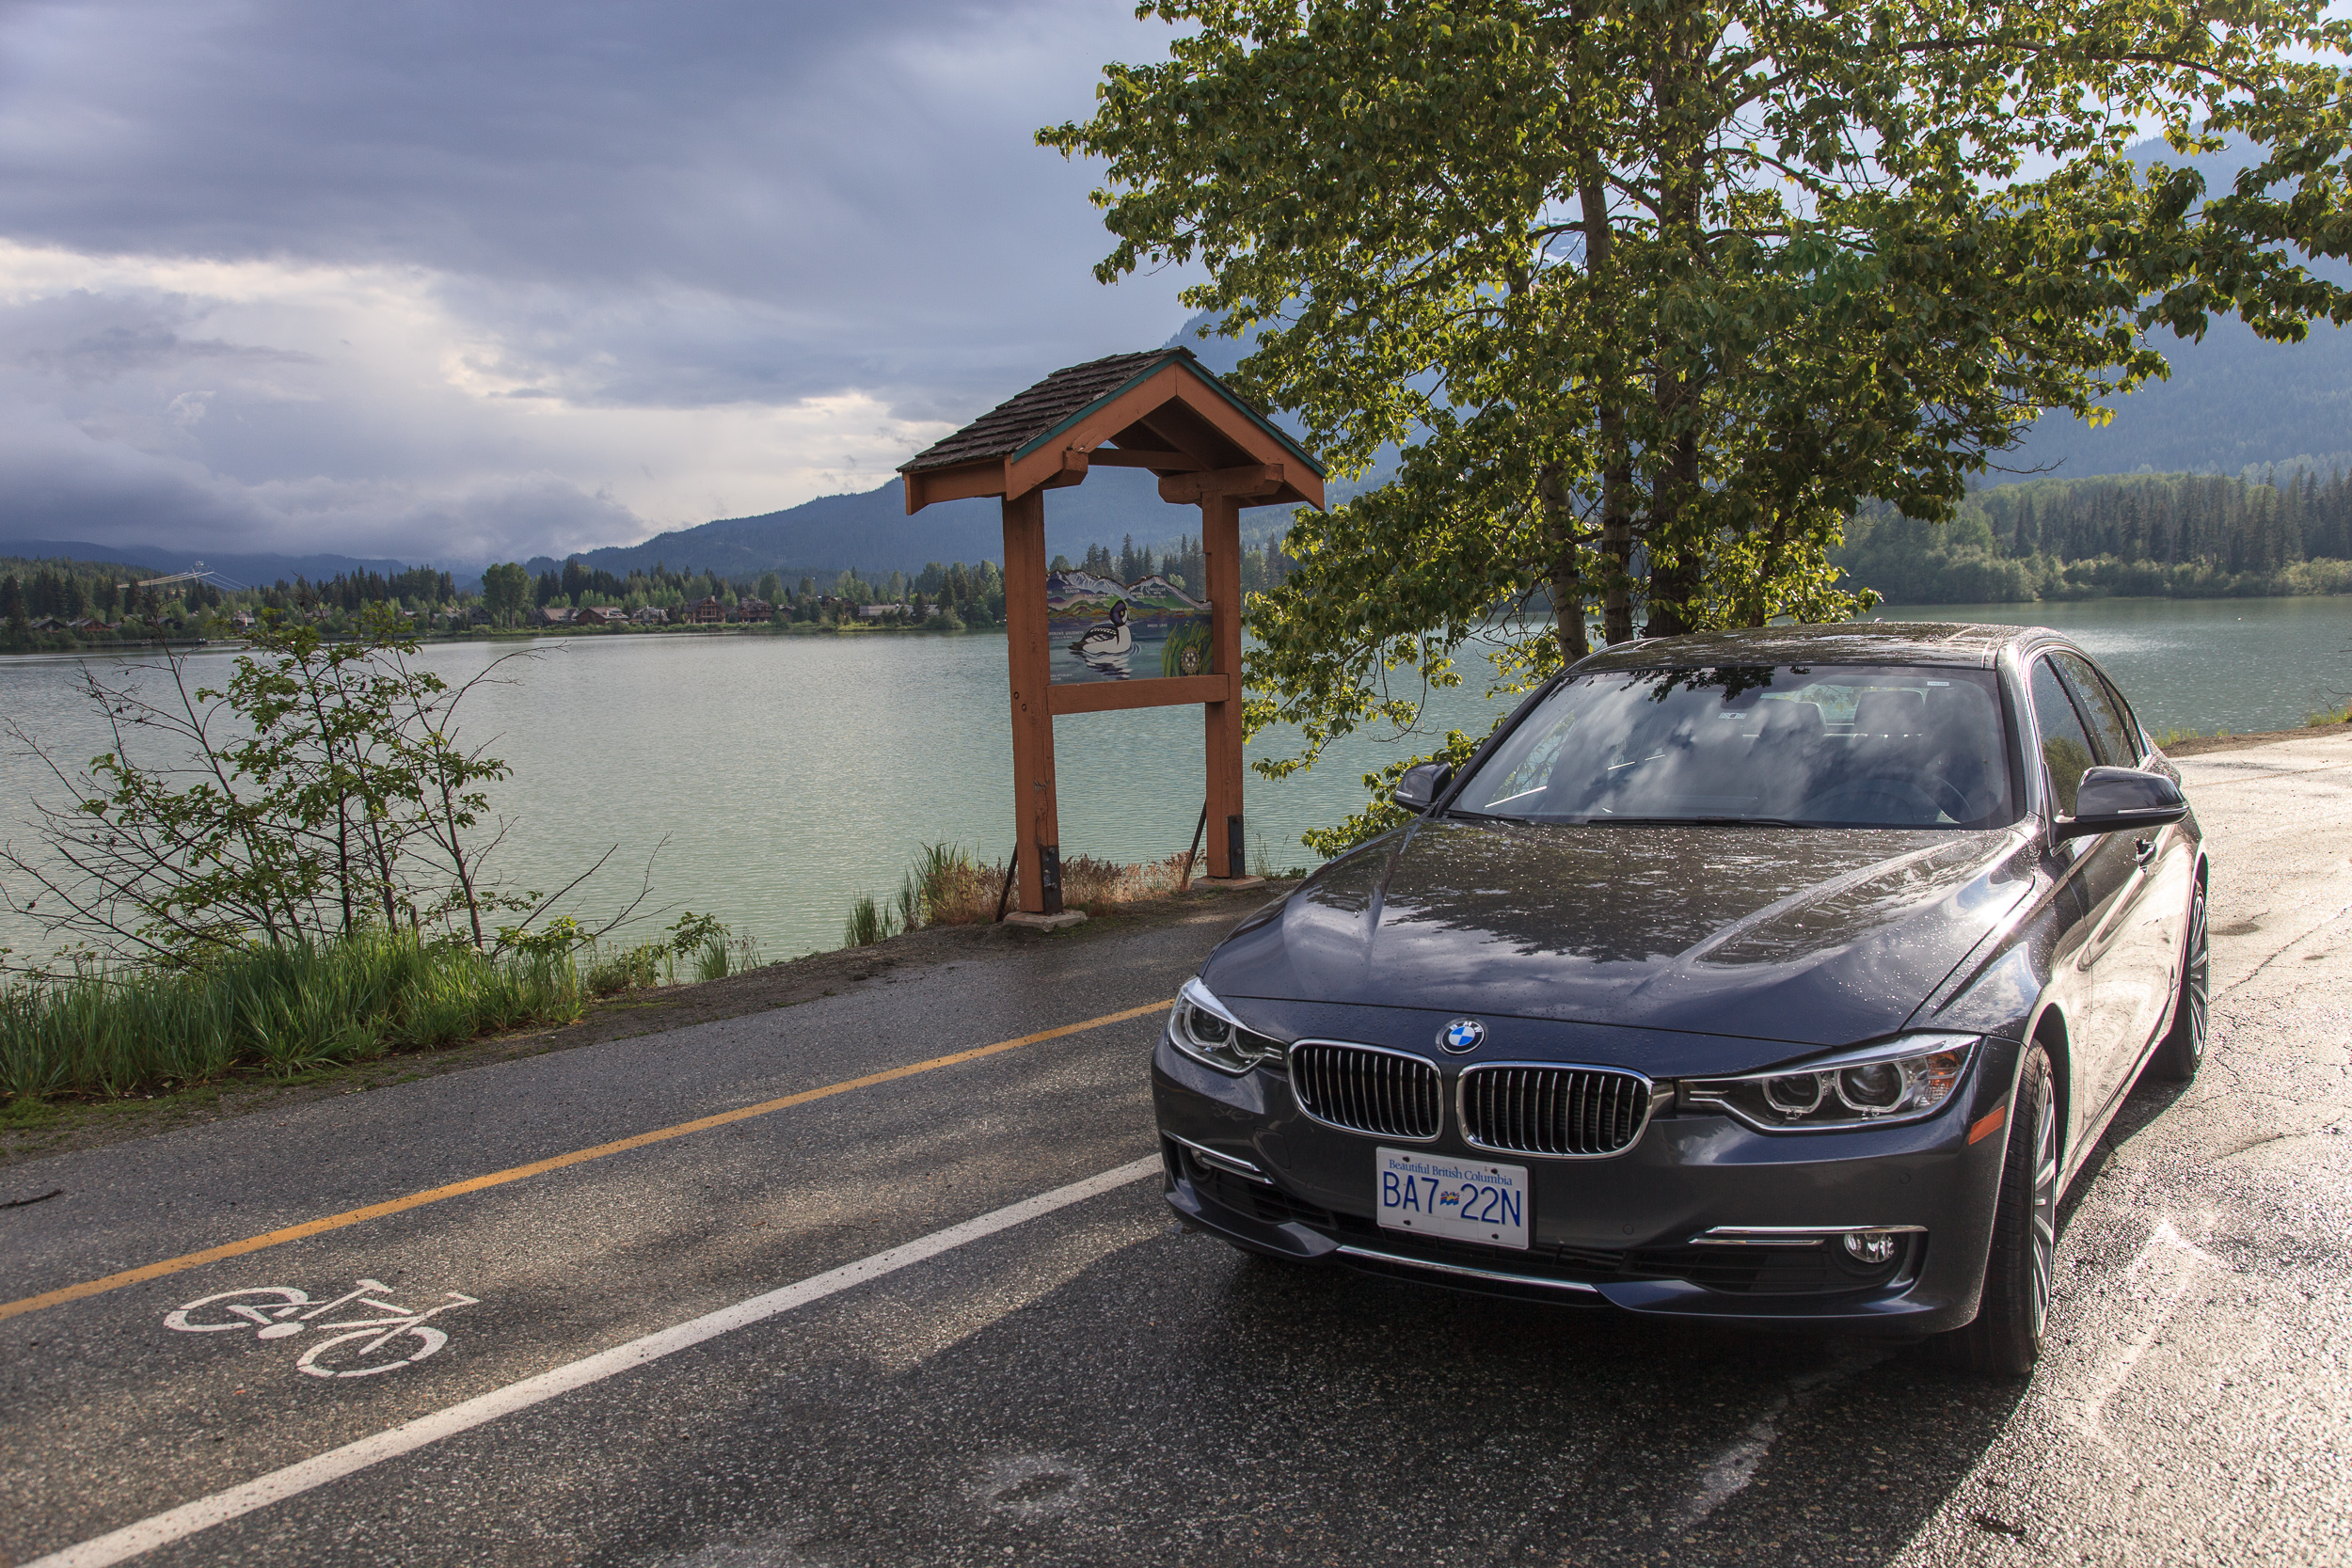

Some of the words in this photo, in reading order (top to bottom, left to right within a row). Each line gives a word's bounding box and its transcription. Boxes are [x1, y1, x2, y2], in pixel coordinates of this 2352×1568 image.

[1450, 1021, 1483, 1033] BMW
[1389, 1159, 1430, 1175] Beautiful
[1432, 1165, 1463, 1180] British
[1464, 1171, 1513, 1186] Columbia
[1383, 1171, 1439, 1214] BA7
[1460, 1183, 1521, 1227] 22N
